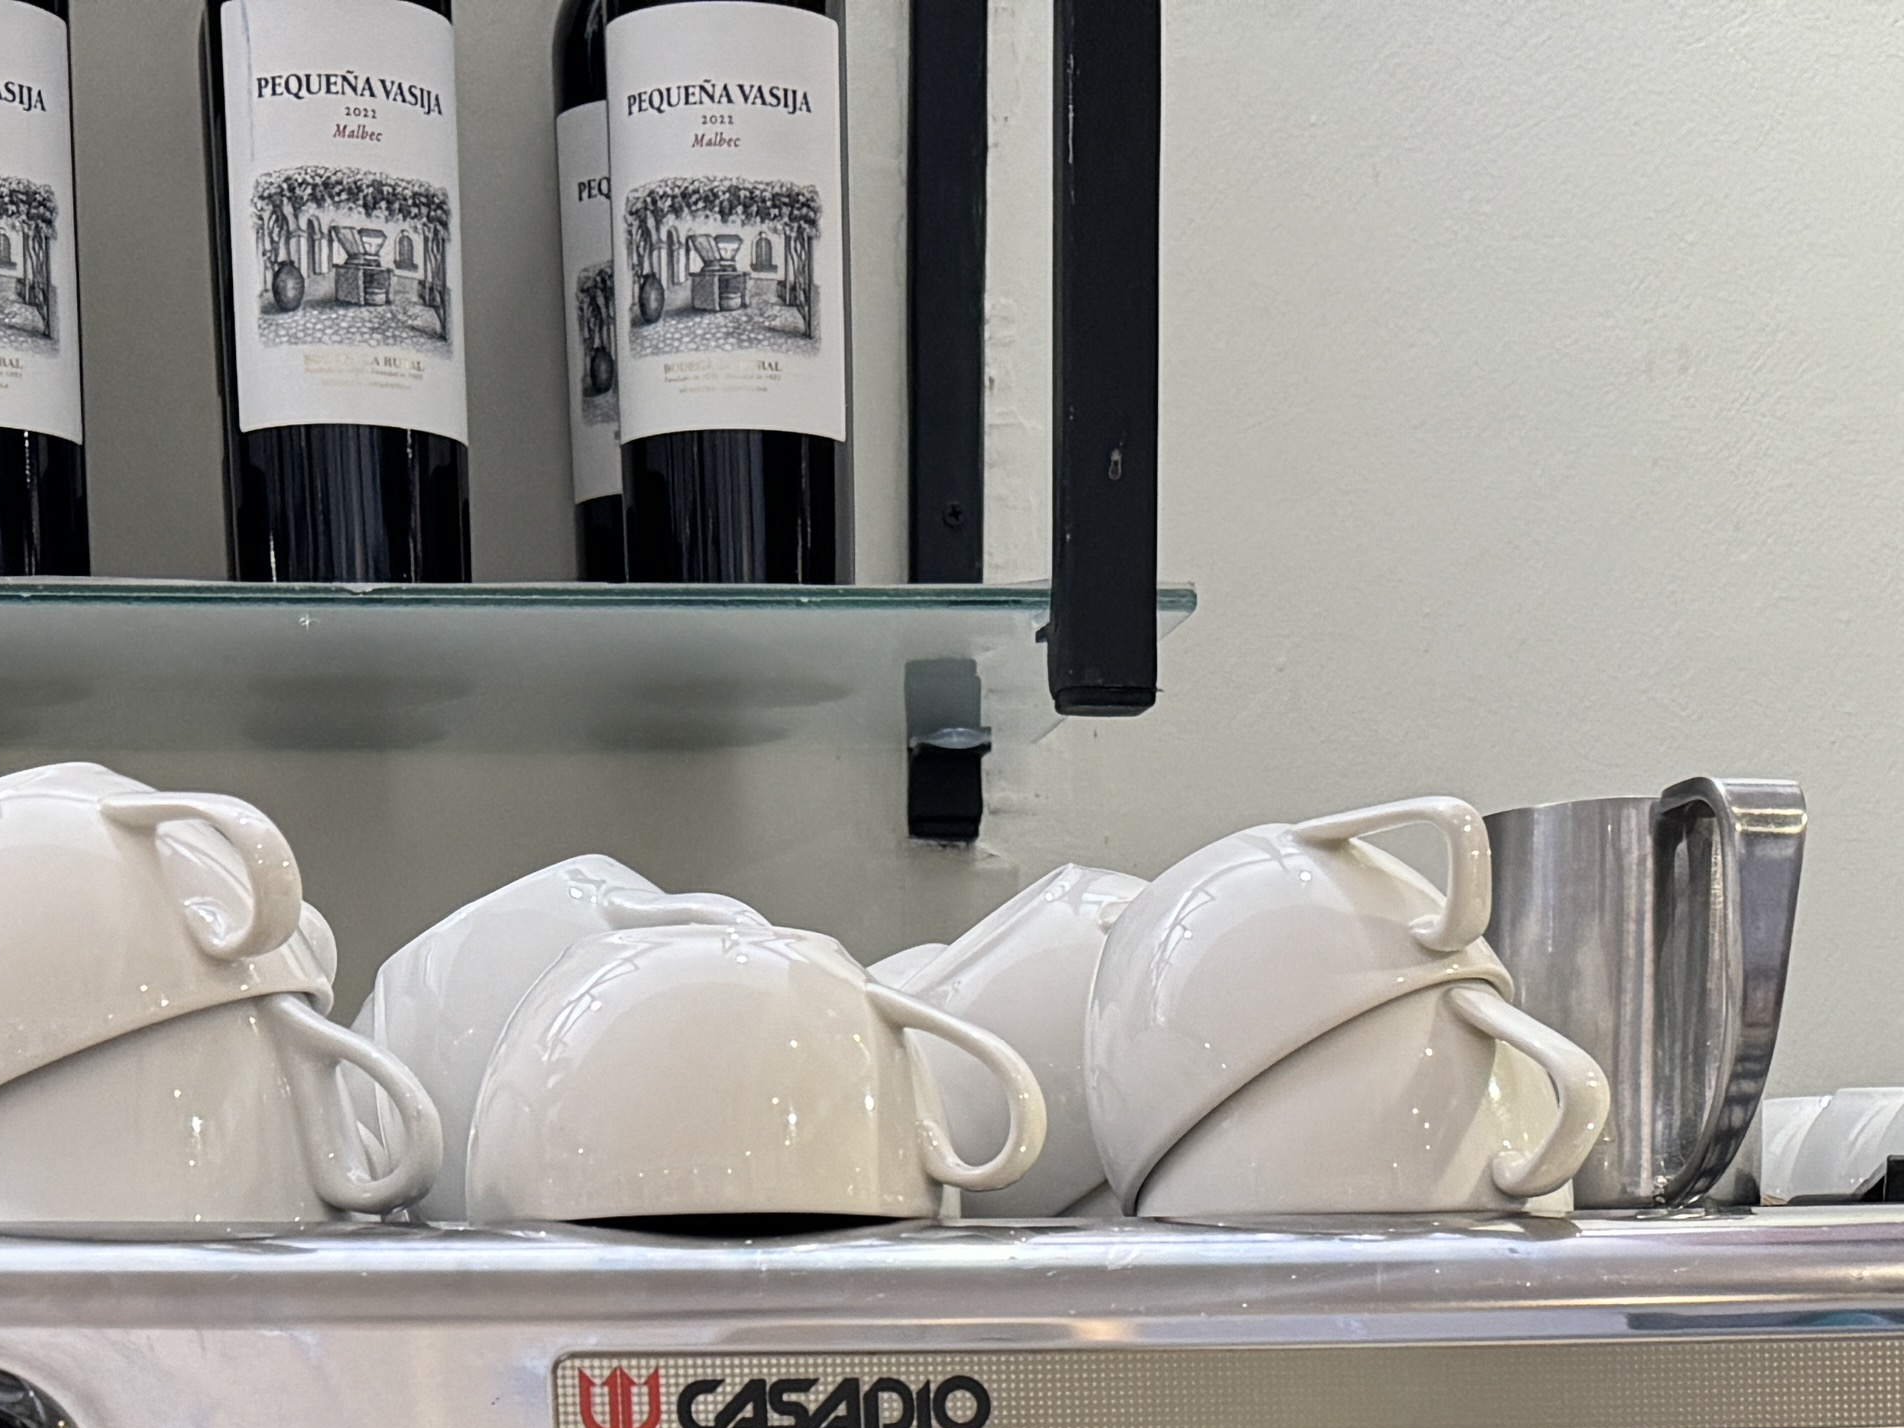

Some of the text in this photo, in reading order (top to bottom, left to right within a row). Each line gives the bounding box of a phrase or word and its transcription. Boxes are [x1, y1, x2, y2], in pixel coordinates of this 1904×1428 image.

[256, 70, 443, 116] PEQUEÑA VASIJA
[627, 79, 812, 116] PEQUEÑA VASIJA
[344, 106, 377, 119] 2022
[701, 114, 734, 125] 2022
[333, 124, 383, 142] Malbec
[692, 133, 741, 148] Malbec
